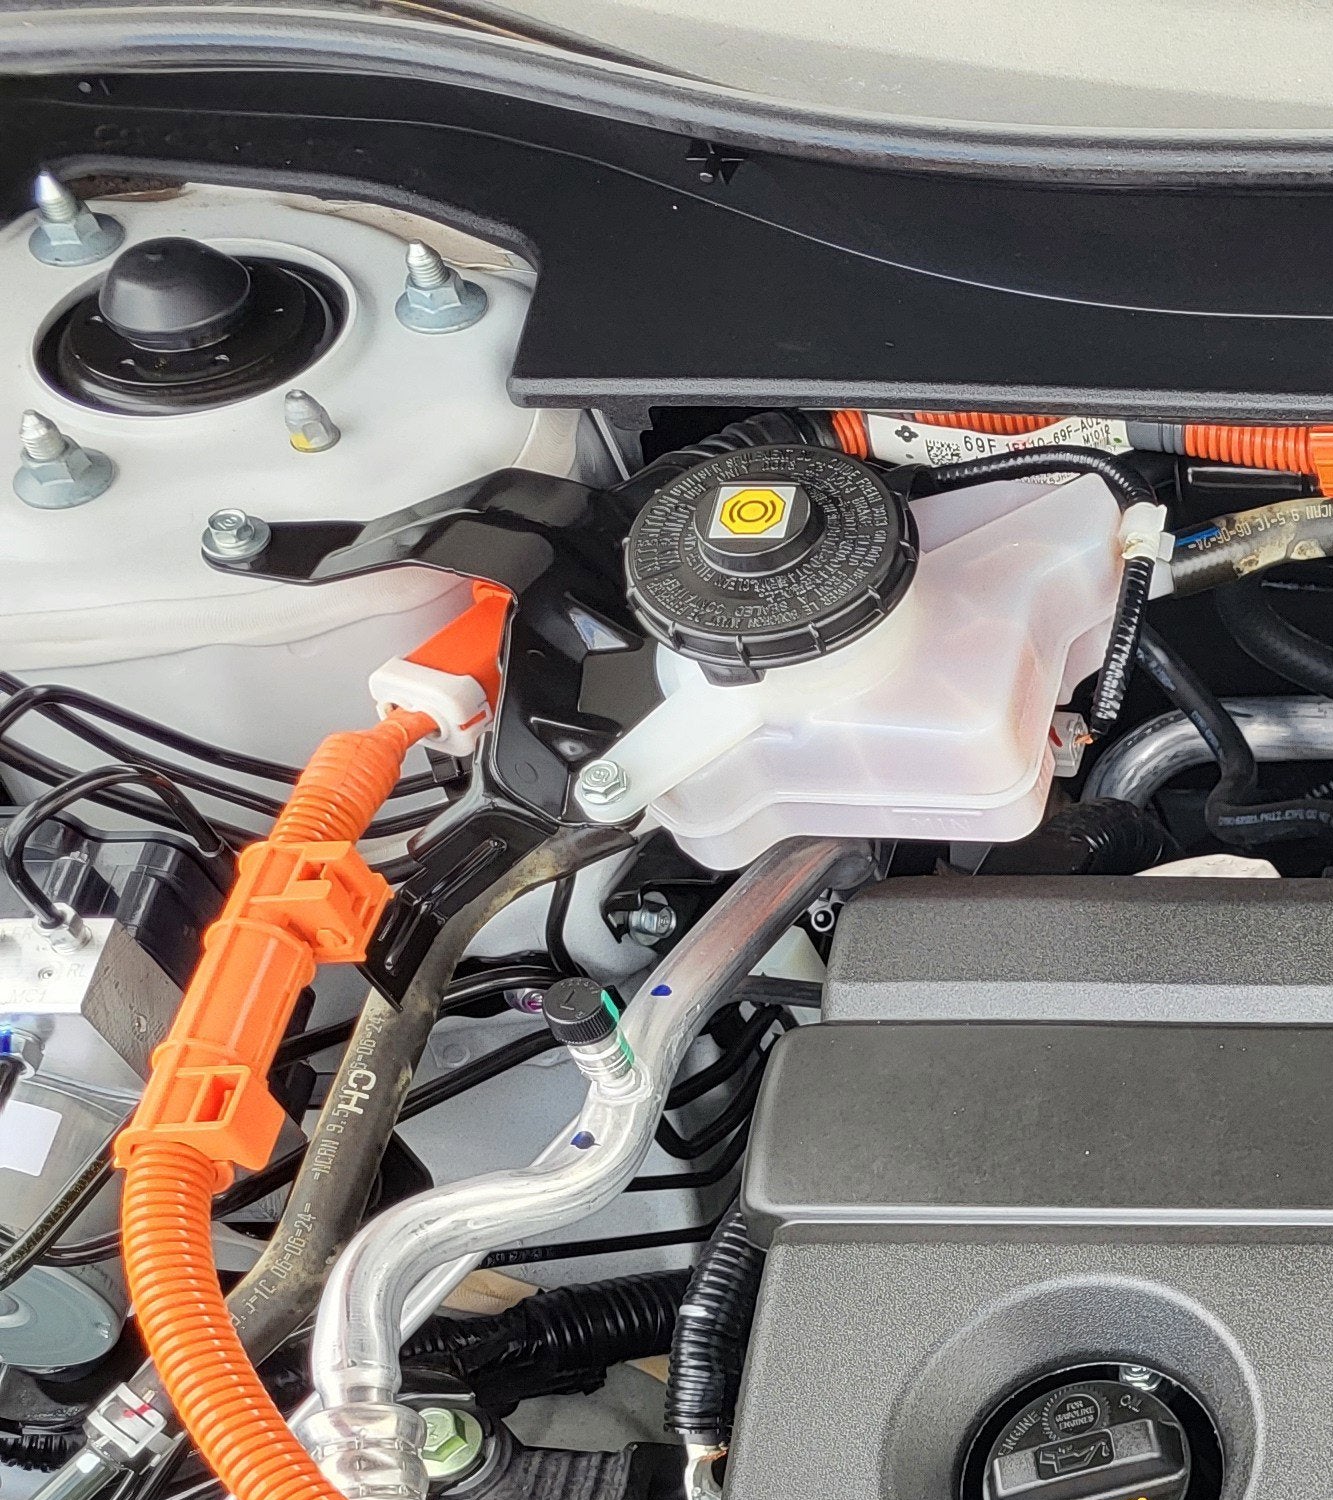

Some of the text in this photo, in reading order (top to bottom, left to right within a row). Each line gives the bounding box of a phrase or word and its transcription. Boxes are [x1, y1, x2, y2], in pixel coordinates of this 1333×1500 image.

[963, 434, 997, 454] 69F
[338, 1067, 377, 1116] CH
[1065, 1399, 1085, 1412] FOR
[998, 1409, 1043, 1456] ENGINE
